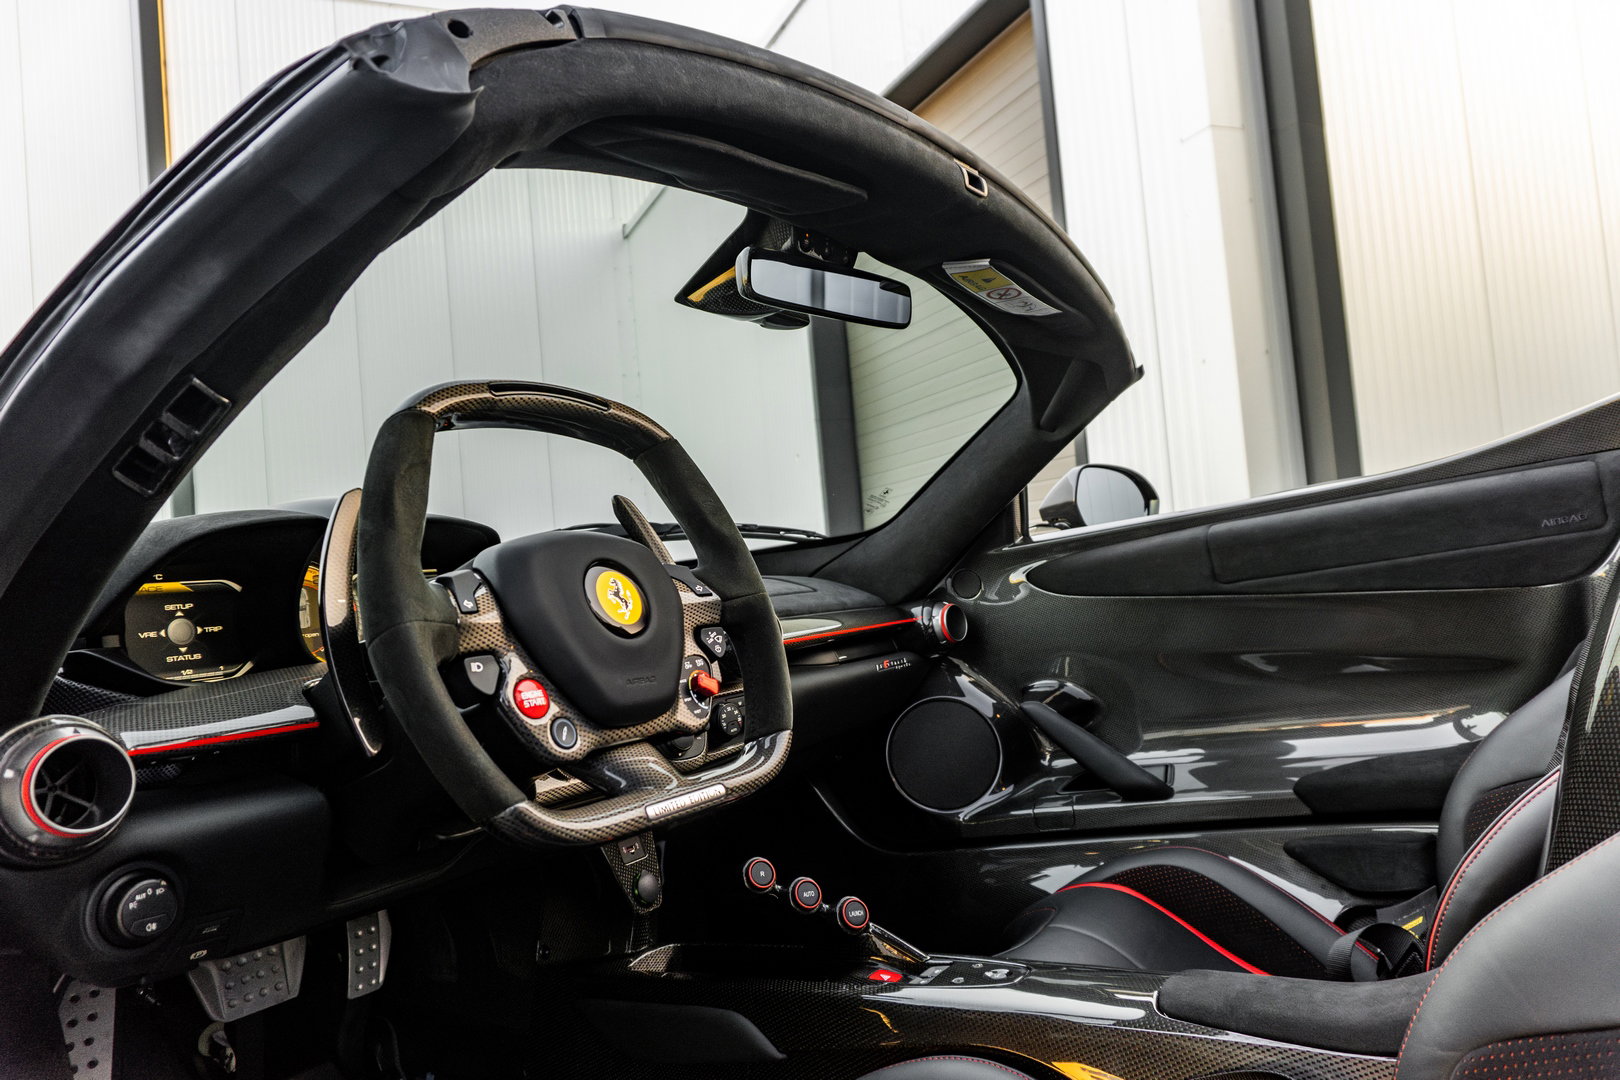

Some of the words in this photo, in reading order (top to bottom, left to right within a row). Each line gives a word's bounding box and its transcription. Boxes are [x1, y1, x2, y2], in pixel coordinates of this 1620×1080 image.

[164, 603, 194, 611] SETUP
[203, 625, 223, 633] TRIP
[166, 653, 202, 663] STATUS
[523, 698, 546, 708] START
[653, 801, 687, 817] LIMITED
[688, 789, 721, 805] EDITION
[803, 890, 815, 898] AUTO
[848, 909, 865, 918] LAUNCH
